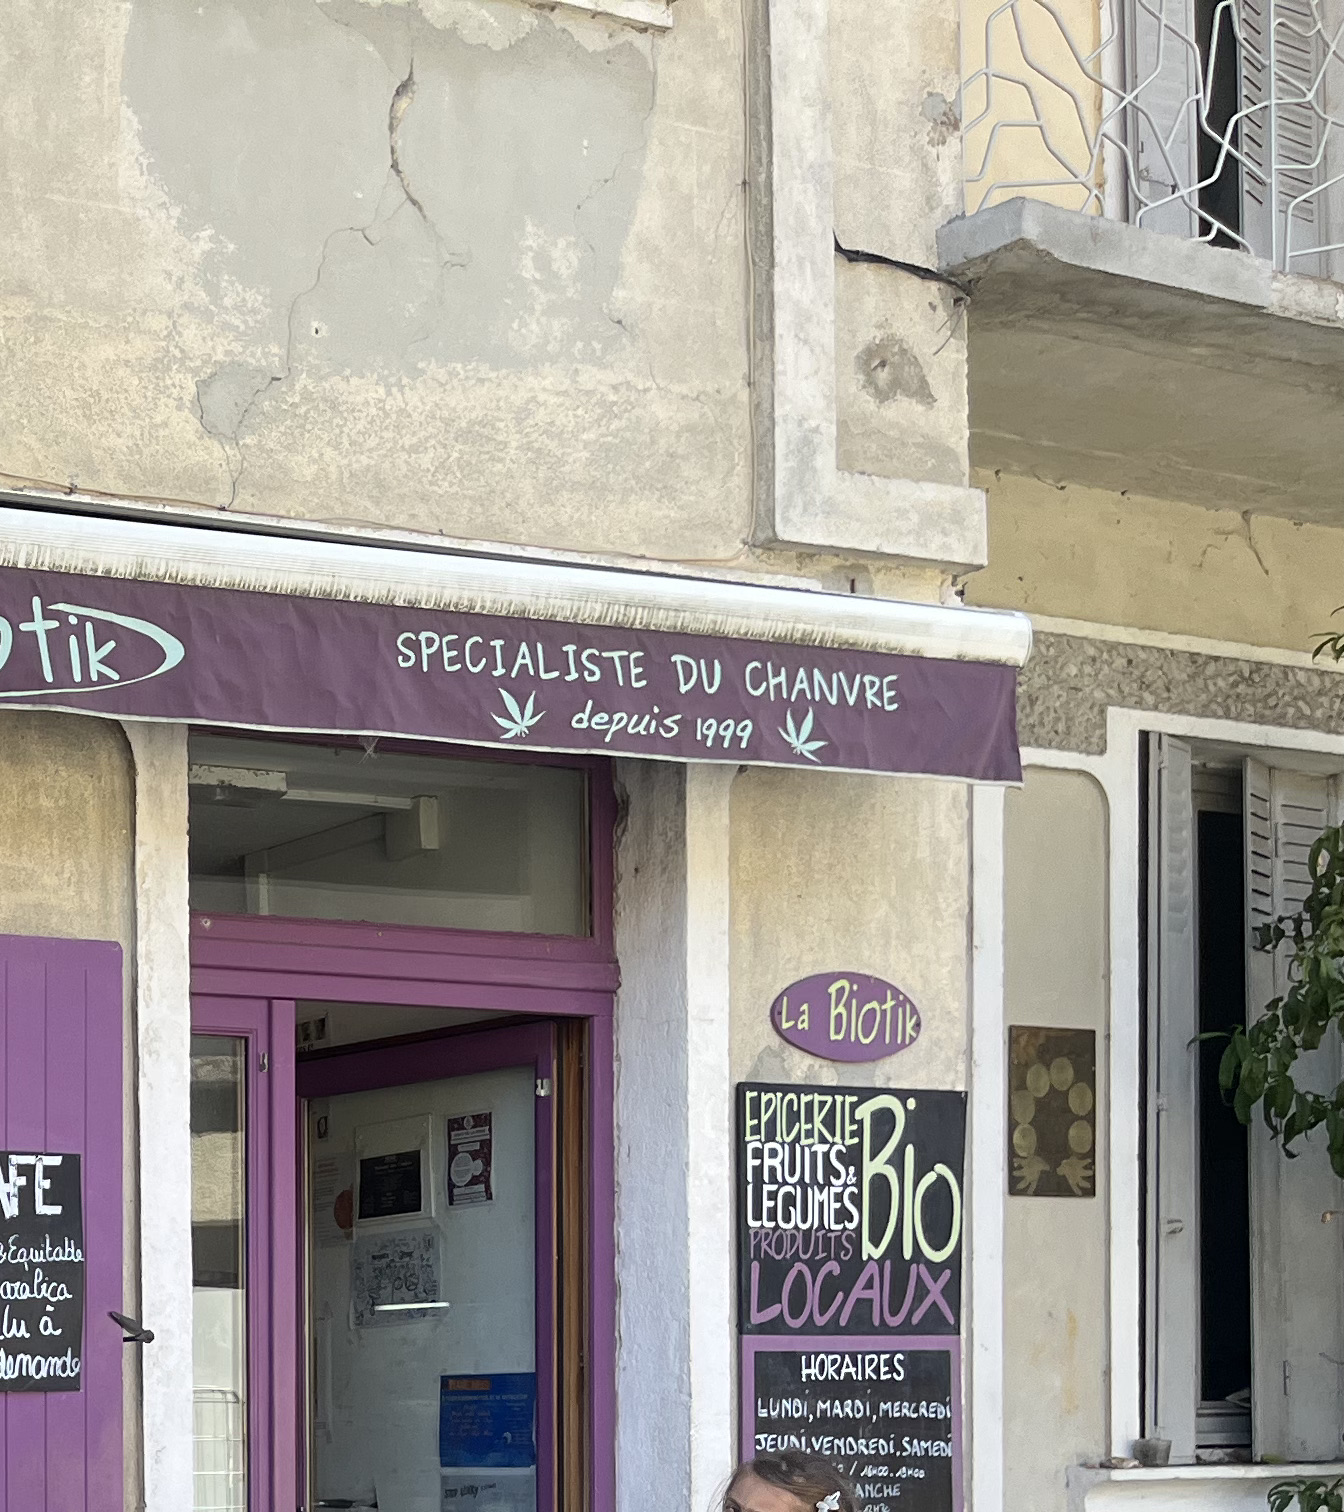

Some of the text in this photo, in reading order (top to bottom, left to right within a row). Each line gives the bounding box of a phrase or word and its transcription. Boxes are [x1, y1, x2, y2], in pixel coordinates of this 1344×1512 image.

[396, 630, 900, 712] SPECIALISTE DU CHANVRE
[570, 698, 754, 750] depuis 1999
[780, 978, 918, 1045] La Biotik
[744, 1091, 860, 1146] EPICERIE
[746, 1141, 858, 1186] FRUITS &
[746, 1183, 860, 1231] LEGUMES
[749, 1228, 857, 1260] PRODUITS
[0, 1267, 73, 1302] arabica
[749, 1259, 956, 1329] LOCAUX
[800, 1352, 905, 1382] HORAIRES
[853, 1483, 902, 1499] ANCHE
